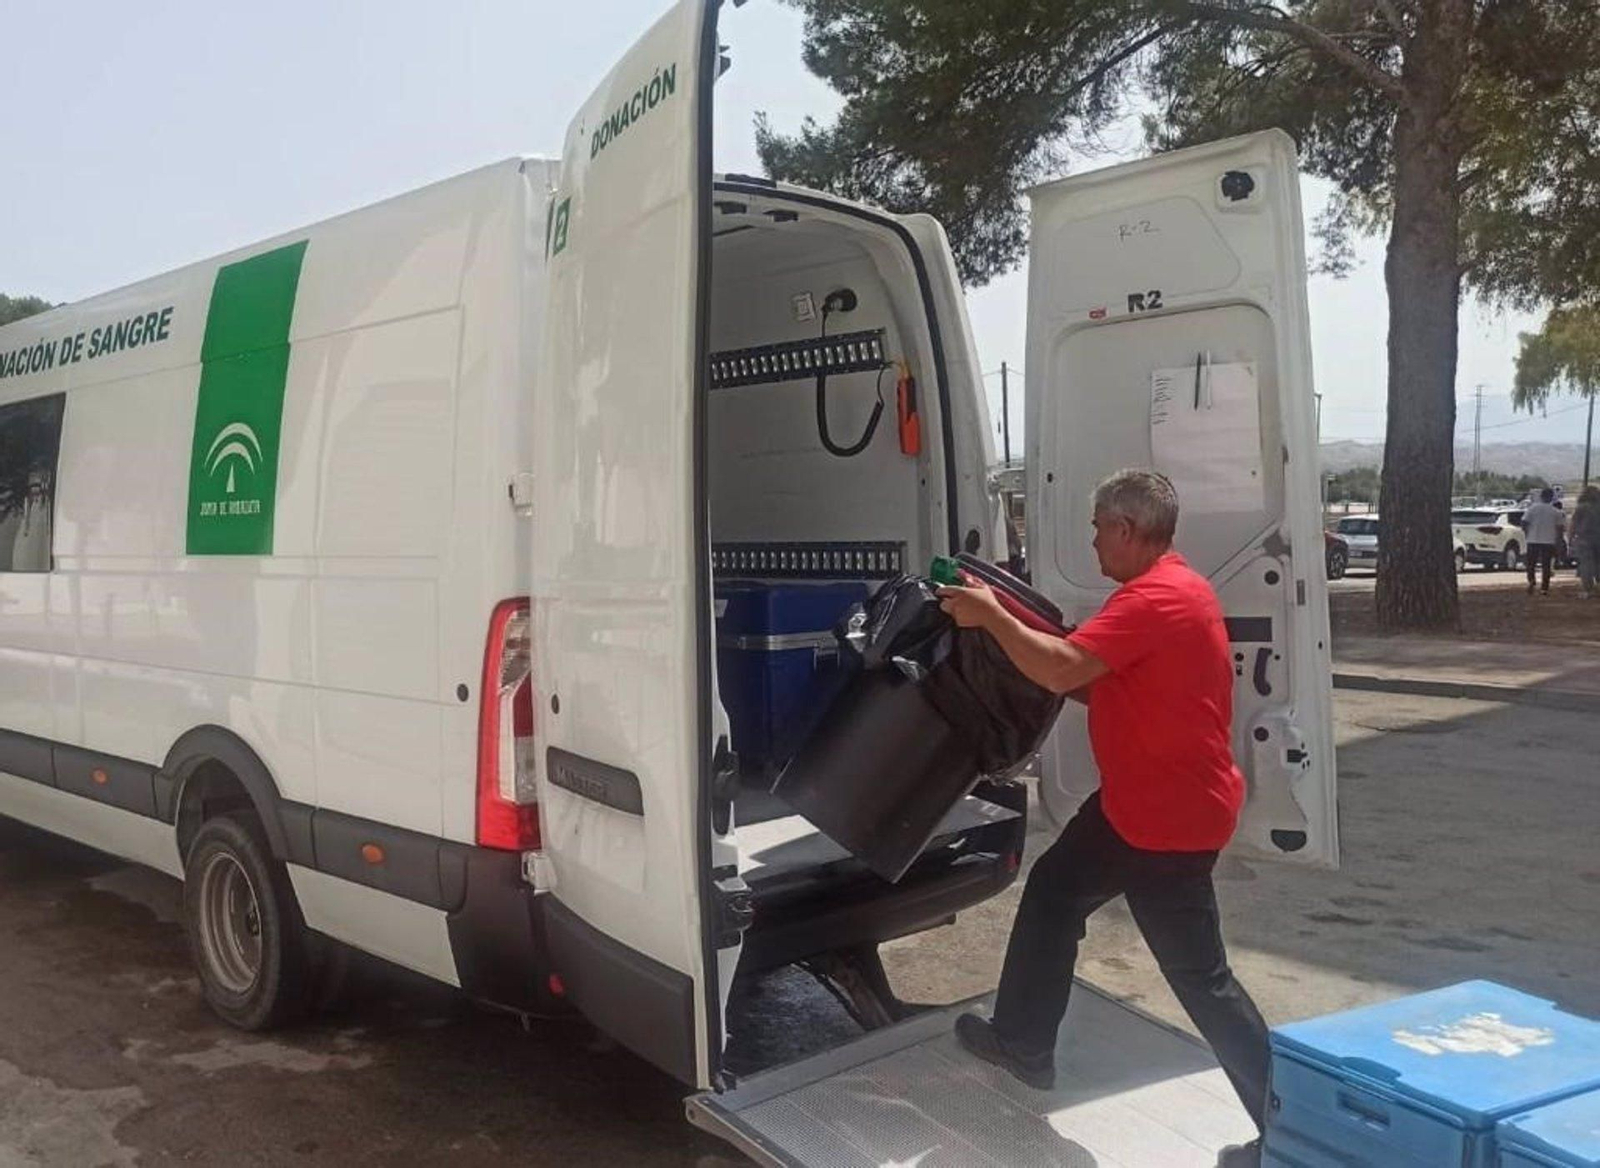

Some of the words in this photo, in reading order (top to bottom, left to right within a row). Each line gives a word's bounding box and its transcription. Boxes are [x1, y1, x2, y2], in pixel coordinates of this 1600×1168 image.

[590, 62, 676, 160] DONACIÓN
[1127, 290, 1163, 313] R2
[59, 332, 86, 367] DE
[88, 306, 174, 359] SANGRE
